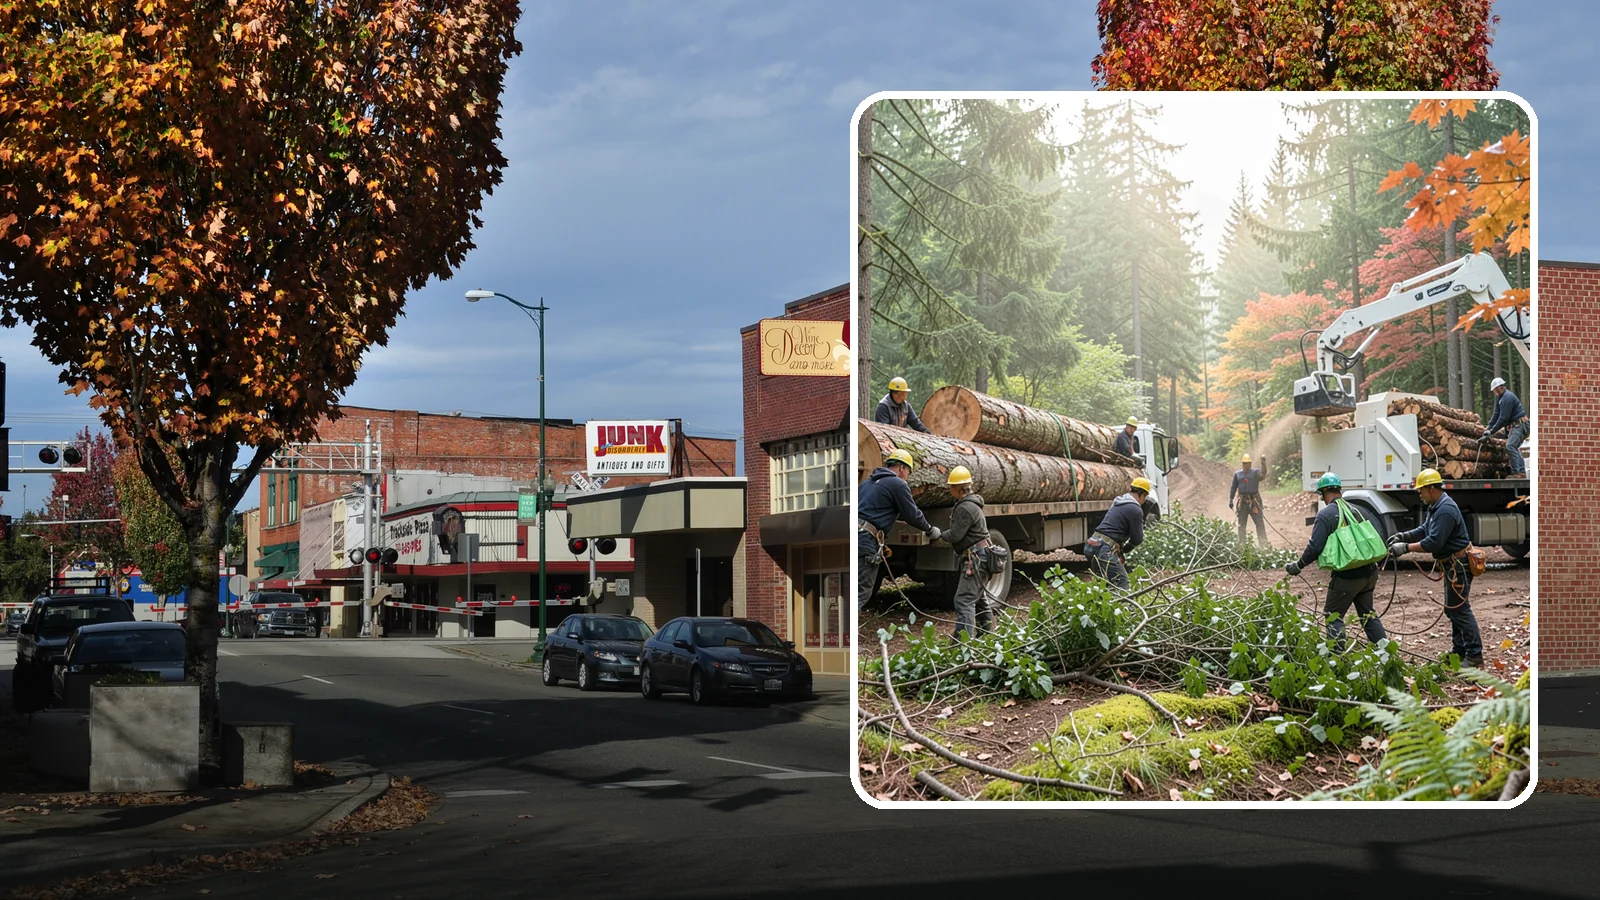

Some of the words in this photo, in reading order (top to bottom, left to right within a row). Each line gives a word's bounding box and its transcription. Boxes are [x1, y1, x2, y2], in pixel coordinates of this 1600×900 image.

[765, 328, 830, 365] Decor
[595, 425, 665, 457] JUNK
[607, 446, 646, 454] DISORDERLY
[597, 461, 628, 470] ANTIQUES
[631, 461, 643, 470] AND
[647, 461, 665, 470] GIFTS
[415, 519, 429, 535] Pizza
